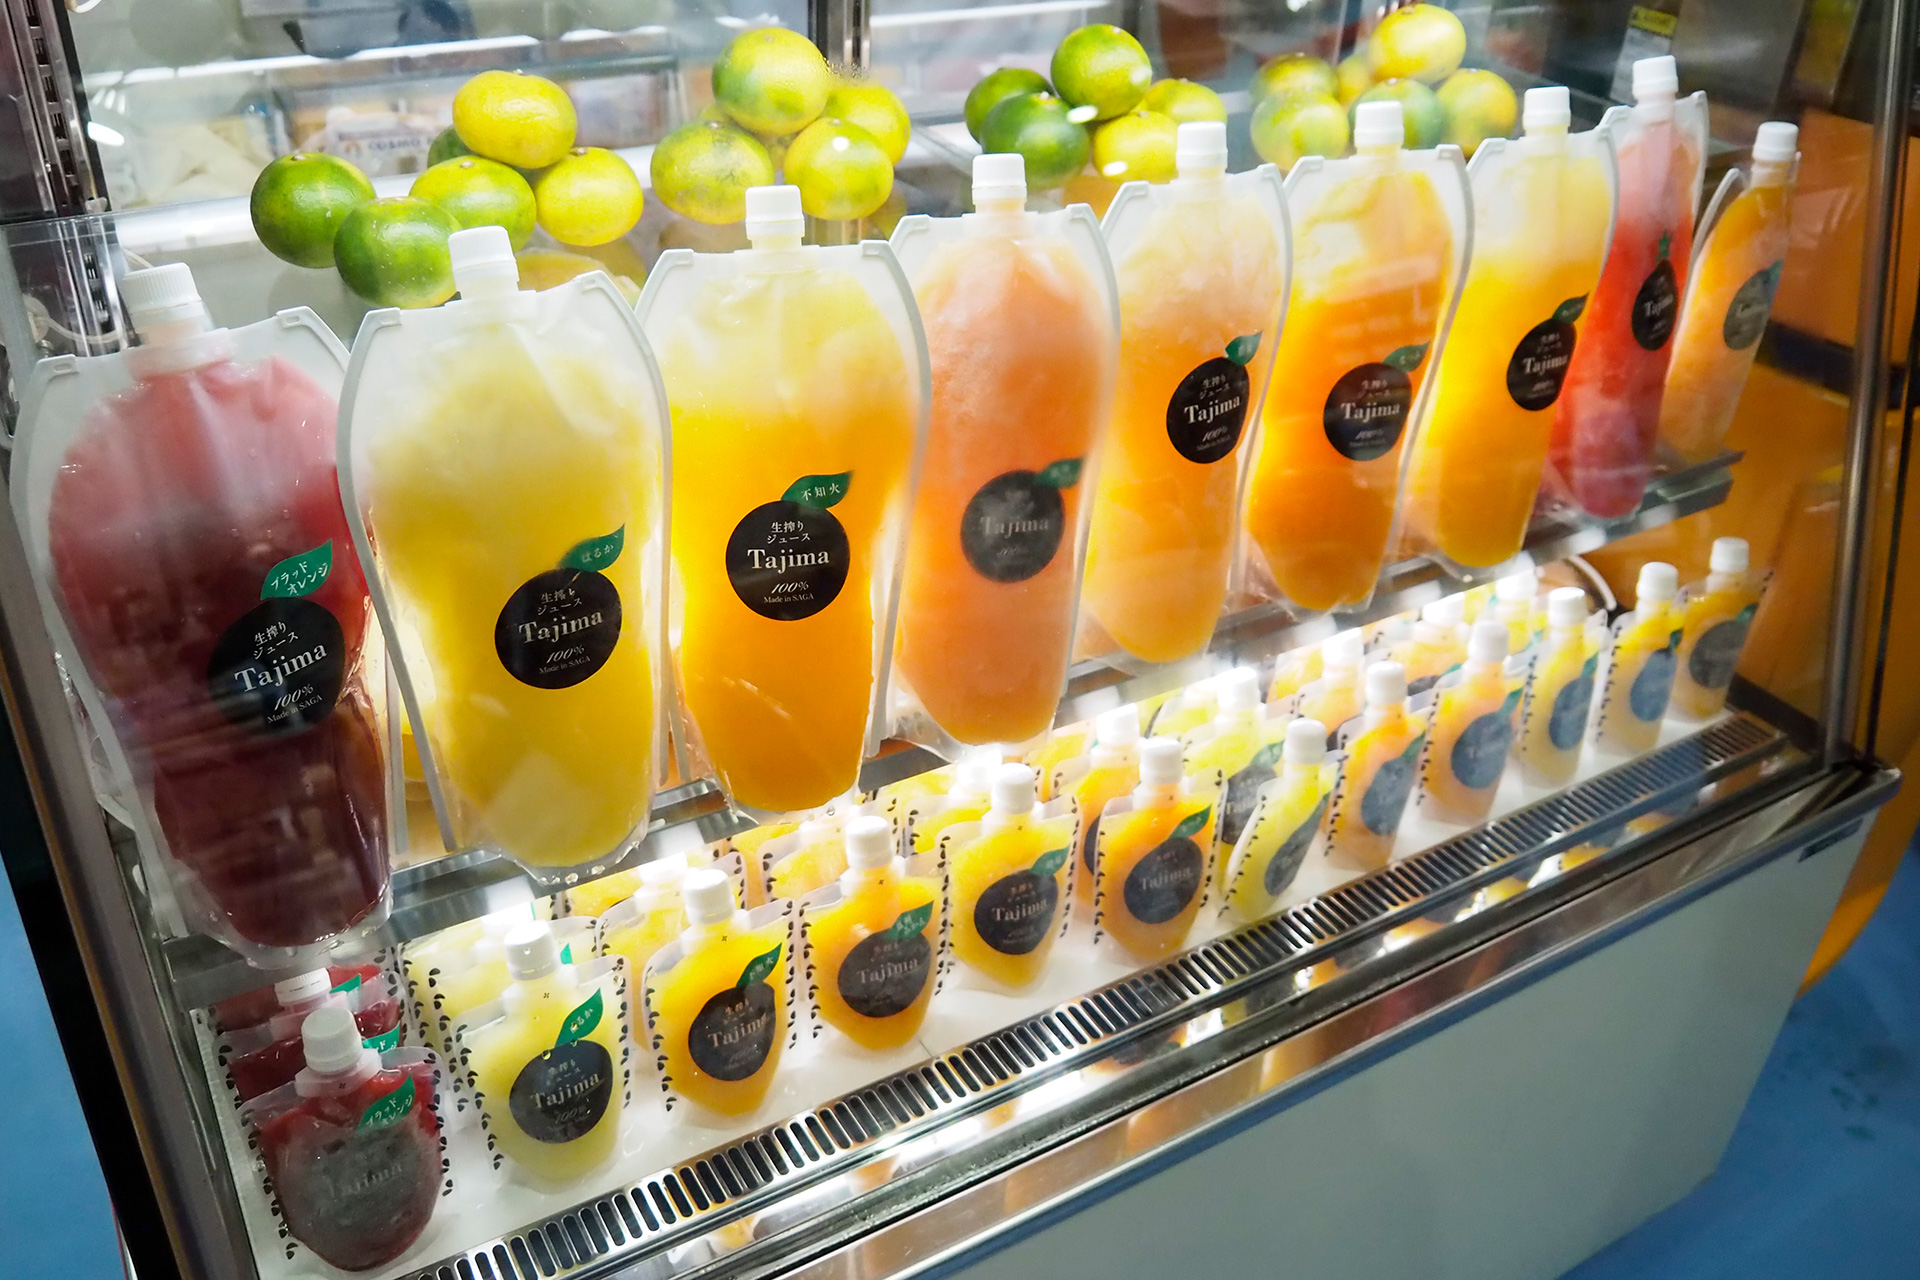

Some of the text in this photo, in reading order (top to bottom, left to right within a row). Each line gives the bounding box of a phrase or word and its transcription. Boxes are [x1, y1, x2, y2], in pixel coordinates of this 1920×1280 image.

[1183, 395, 1241, 424] Tajima
[1340, 402, 1401, 423] Tajima
[801, 482, 841, 501] 不知火
[766, 532, 811, 545] ジュース
[770, 520, 805, 534] 生搾り
[979, 515, 1050, 539] Tajima
[582, 544, 615, 564] はるか
[746, 548, 830, 574] Tajima
[270, 560, 309, 591] ブラッド
[286, 562, 329, 596] オレンジ
[770, 581, 810, 595] 100%
[537, 597, 583, 617] ジュース
[763, 593, 815, 604] Made in SAGA
[253, 620, 287, 648] 生搾り
[518, 611, 604, 645] Tajima
[252, 630, 299, 660] ジュース
[545, 644, 585, 665] 100%
[233, 643, 328, 693] Tajima
[266, 707, 290, 724] Made
[298, 694, 323, 712] SAGA
[273, 683, 314, 711] 100%
[991, 898, 1048, 921] Tajima
[856, 958, 919, 984] Tajima
[707, 1012, 769, 1048] Tajima
[529, 1072, 601, 1110] Tajima
